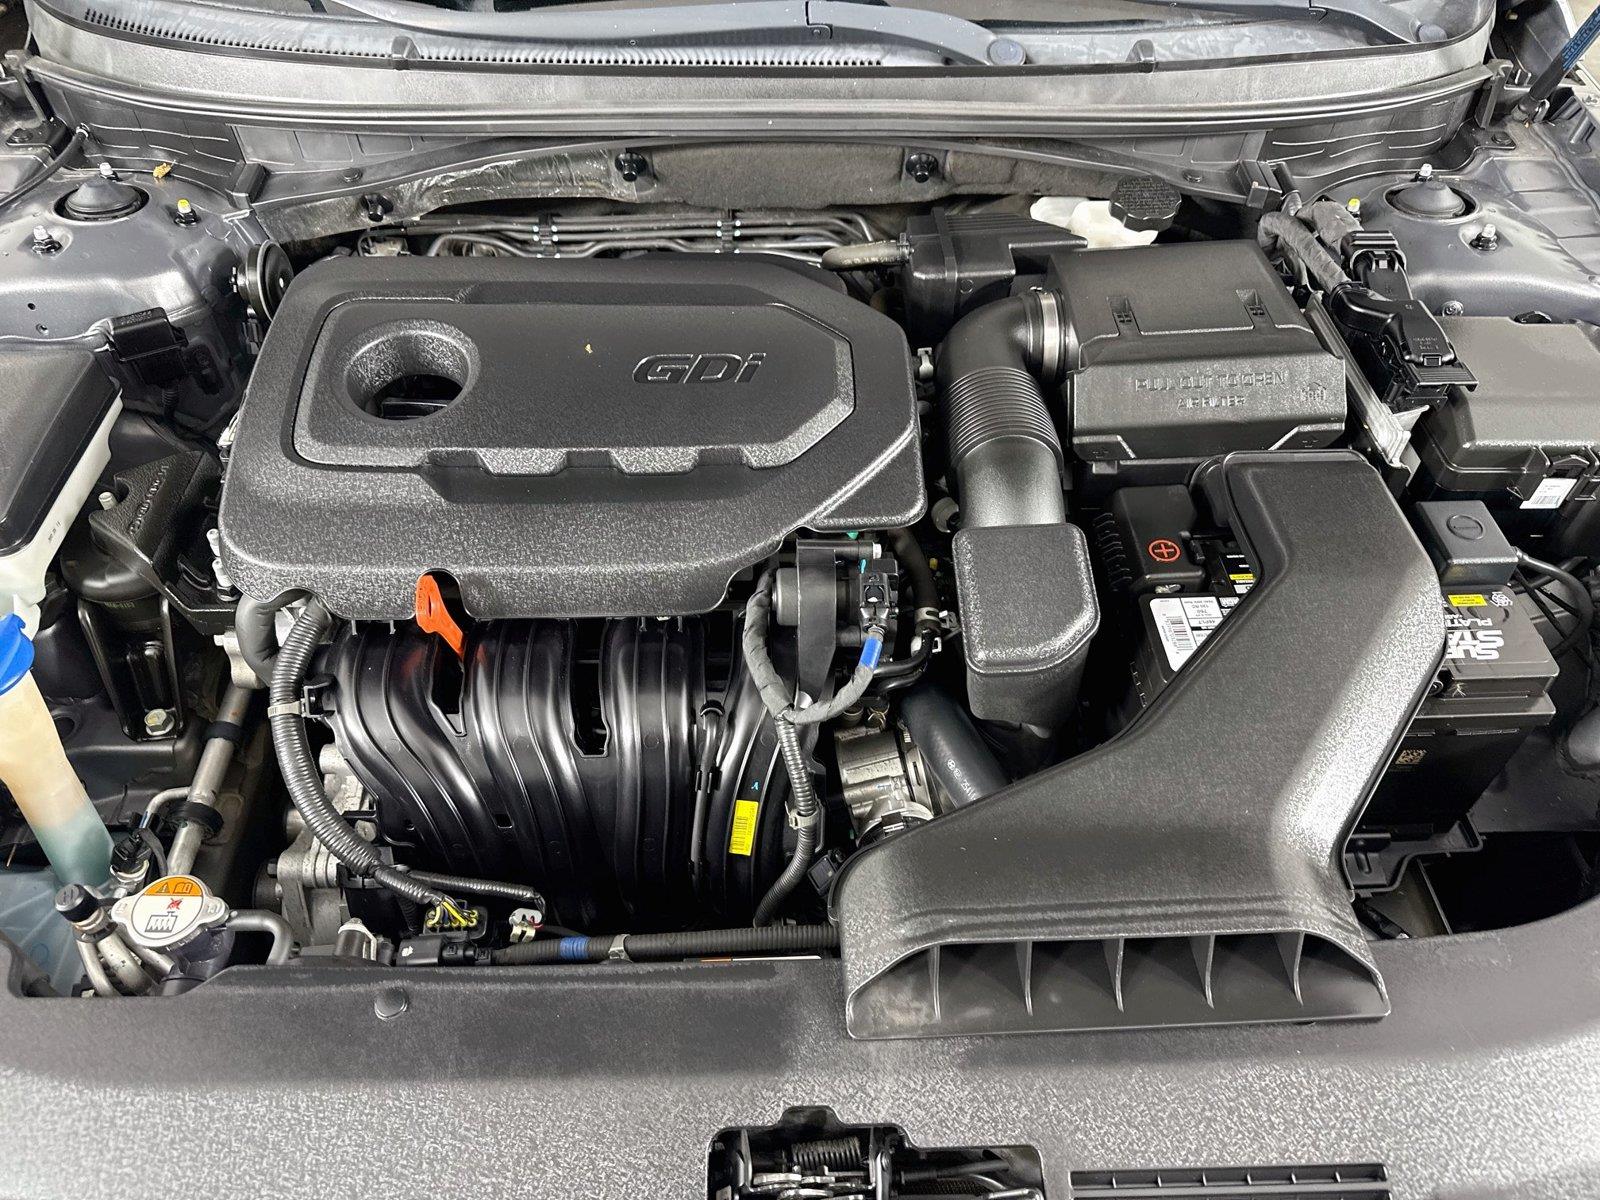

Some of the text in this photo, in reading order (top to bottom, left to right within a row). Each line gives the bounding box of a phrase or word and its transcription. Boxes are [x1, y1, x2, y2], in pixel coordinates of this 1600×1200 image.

[632, 353, 766, 384] GDi
[1135, 371, 1285, 392] PULL OUT TO OPEN
[1177, 396, 1245, 409] AIR FILTER
